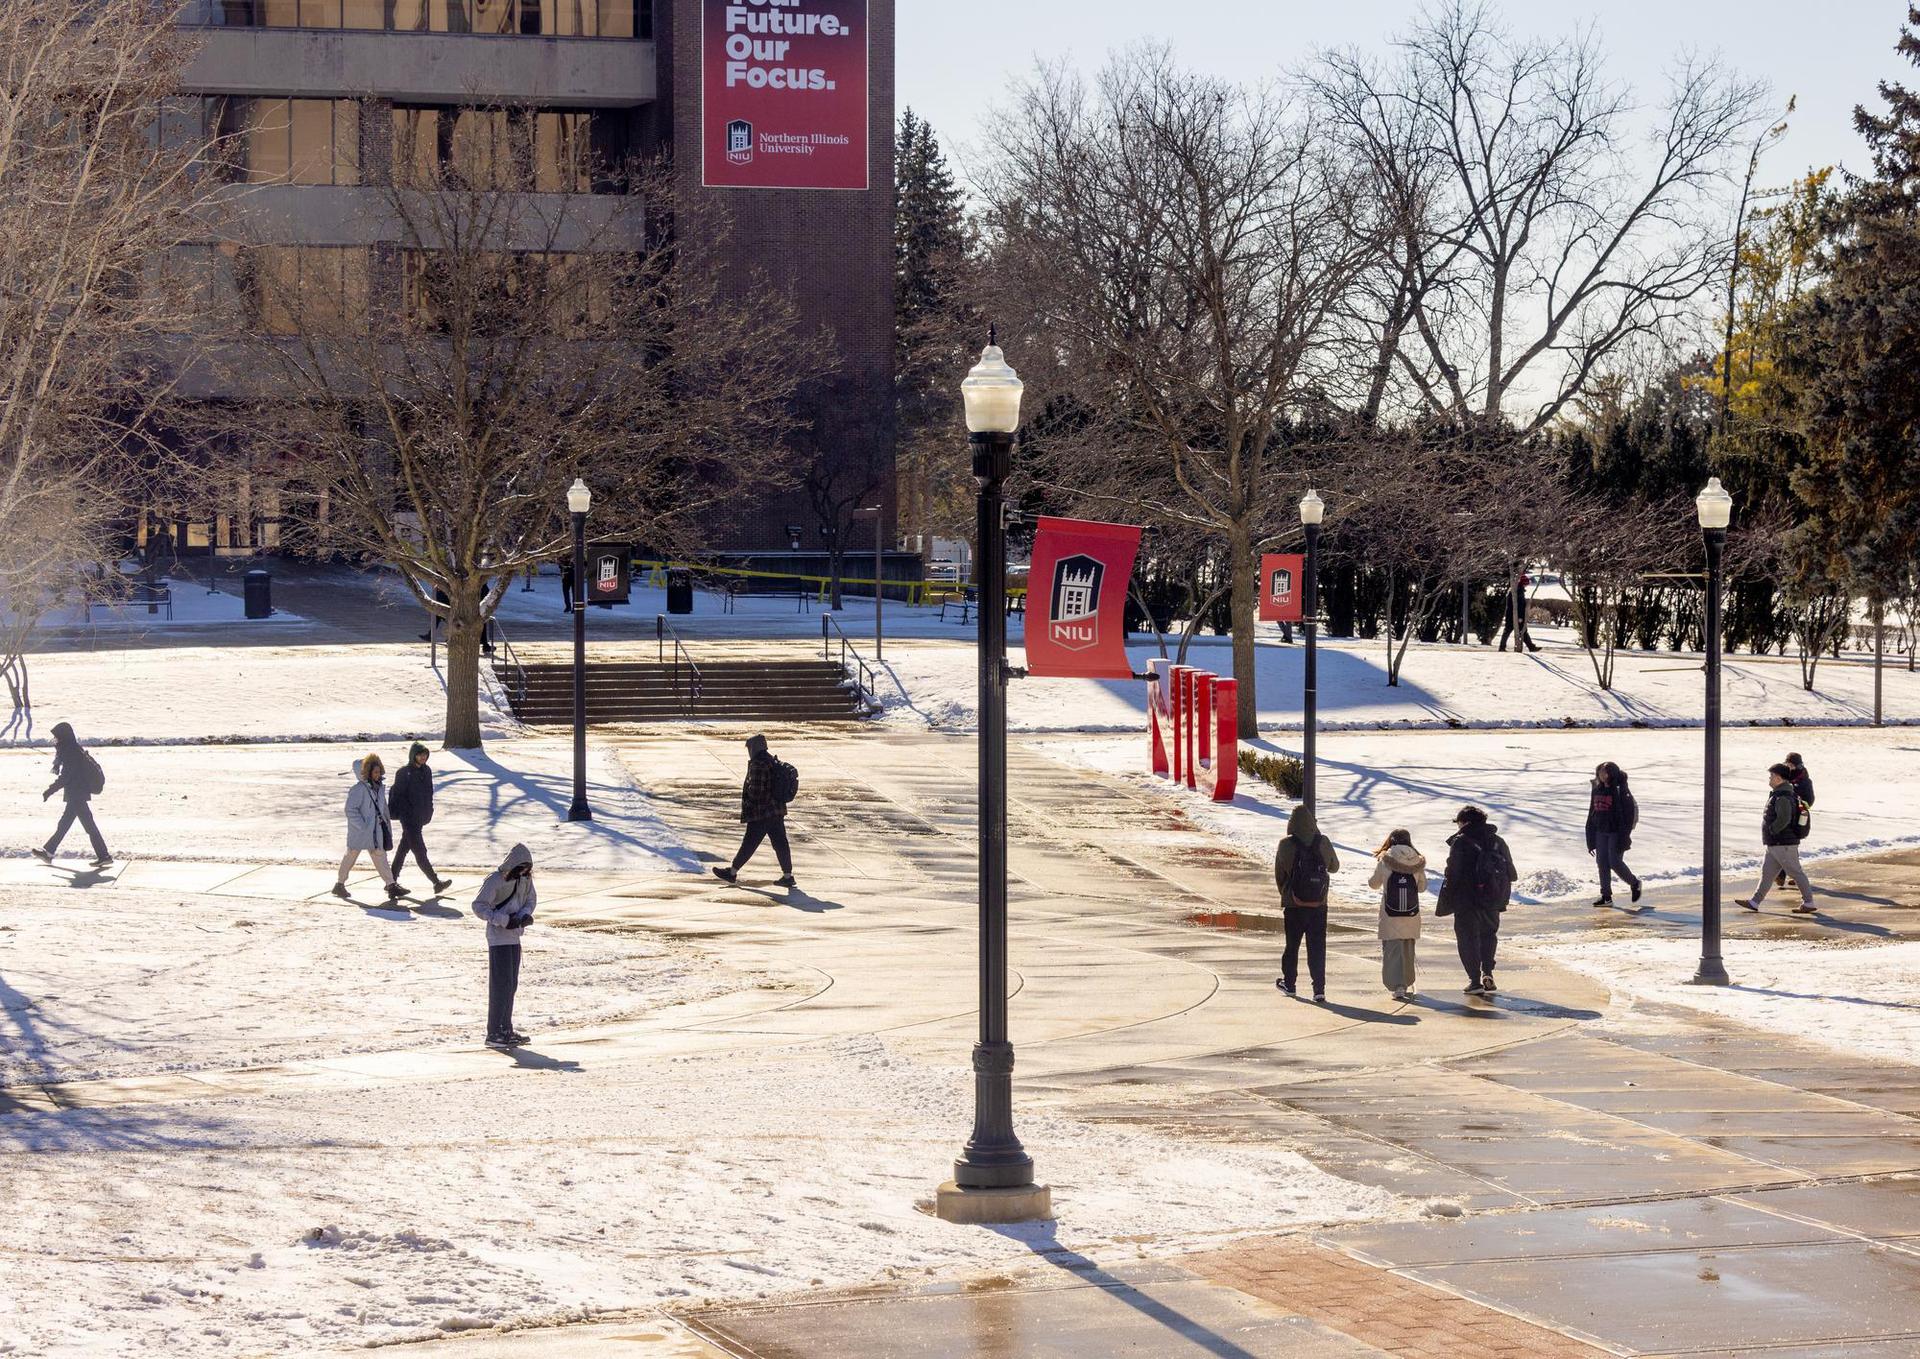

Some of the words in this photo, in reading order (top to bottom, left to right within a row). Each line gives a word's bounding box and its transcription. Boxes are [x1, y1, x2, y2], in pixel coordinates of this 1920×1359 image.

[726, 6, 849, 35] Future.
[725, 33, 790, 61] Our
[726, 61, 836, 90] Focus.
[759, 133, 808, 144] Northern
[811, 134, 849, 145] Illinois
[759, 143, 815, 156] University
[729, 152, 750, 161] NIU
[1055, 625, 1092, 641] NIU
[1146, 658, 1239, 802] NIU
